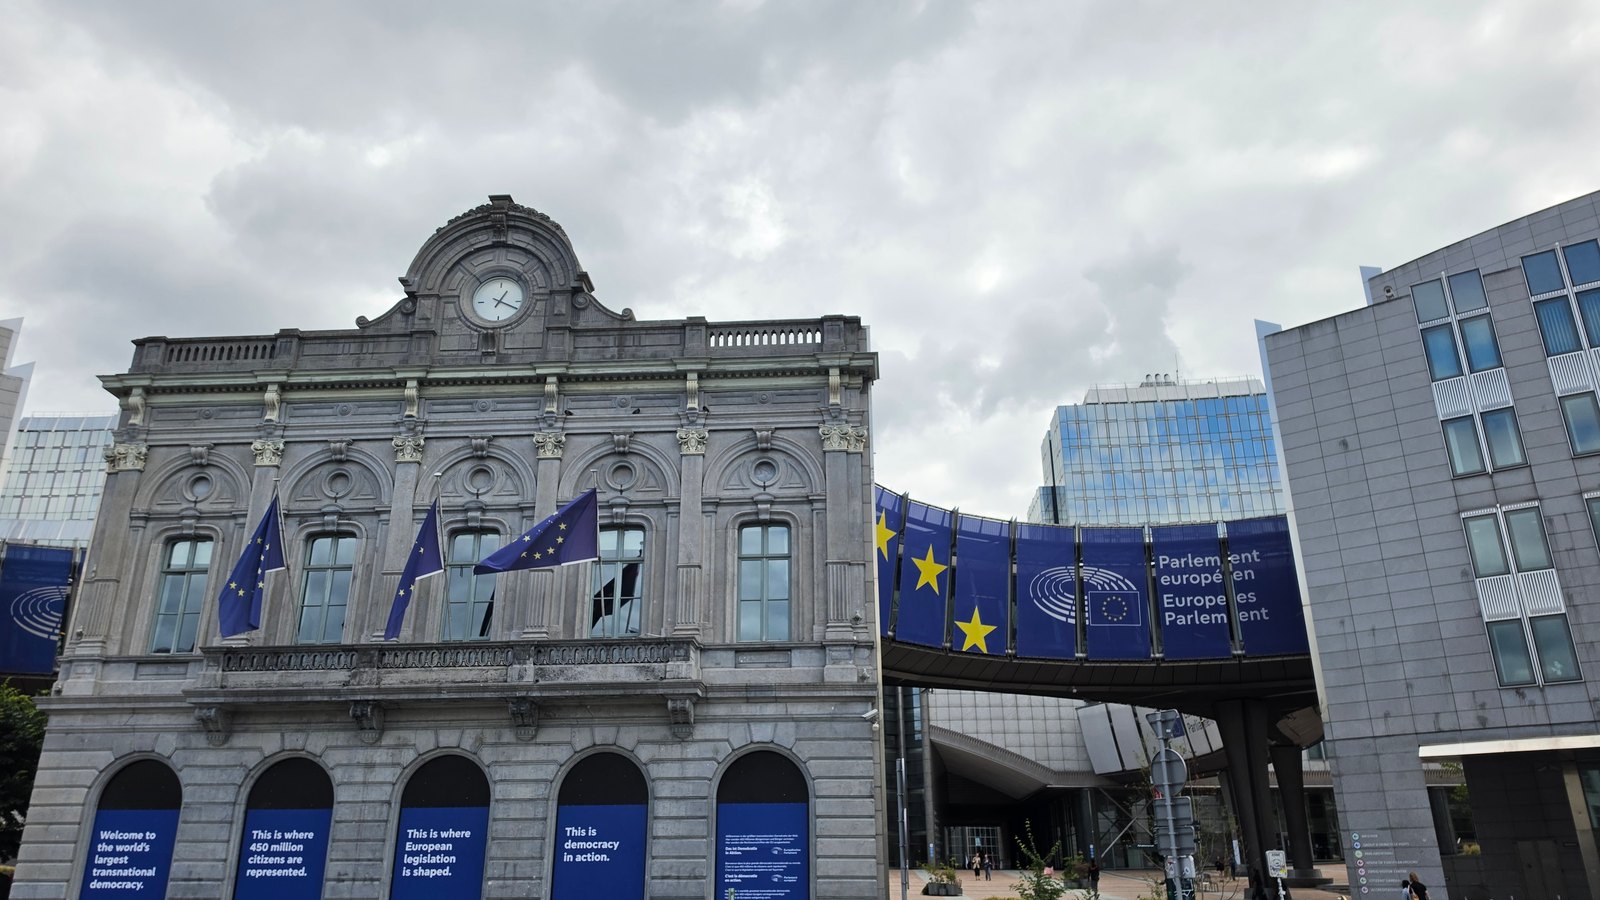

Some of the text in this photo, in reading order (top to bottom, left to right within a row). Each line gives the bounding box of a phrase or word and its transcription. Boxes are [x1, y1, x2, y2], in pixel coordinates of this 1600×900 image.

[1159, 549, 1261, 569] Parlement
[1161, 569, 1255, 587] européen
[1163, 592, 1257, 609] Europees
[1165, 607, 1270, 626] Parlement
[100, 830, 156, 840] Welcome to
[251, 830, 314, 840] This is where
[406, 828, 471, 839] This is where
[565, 827, 597, 837] This is
[97, 842, 150, 852] the world's
[249, 842, 304, 852] 450 million
[405, 841, 453, 854] European
[564, 839, 620, 852] democracy
[94, 854, 129, 867] largest
[247, 854, 303, 865] citizens are
[403, 853, 456, 866] legislation
[564, 852, 610, 862] in action.
[92, 866, 156, 877] transnational
[246, 866, 307, 879] represented.
[402, 866, 452, 879] is shaped.
[89, 879, 144, 891] democracy.
